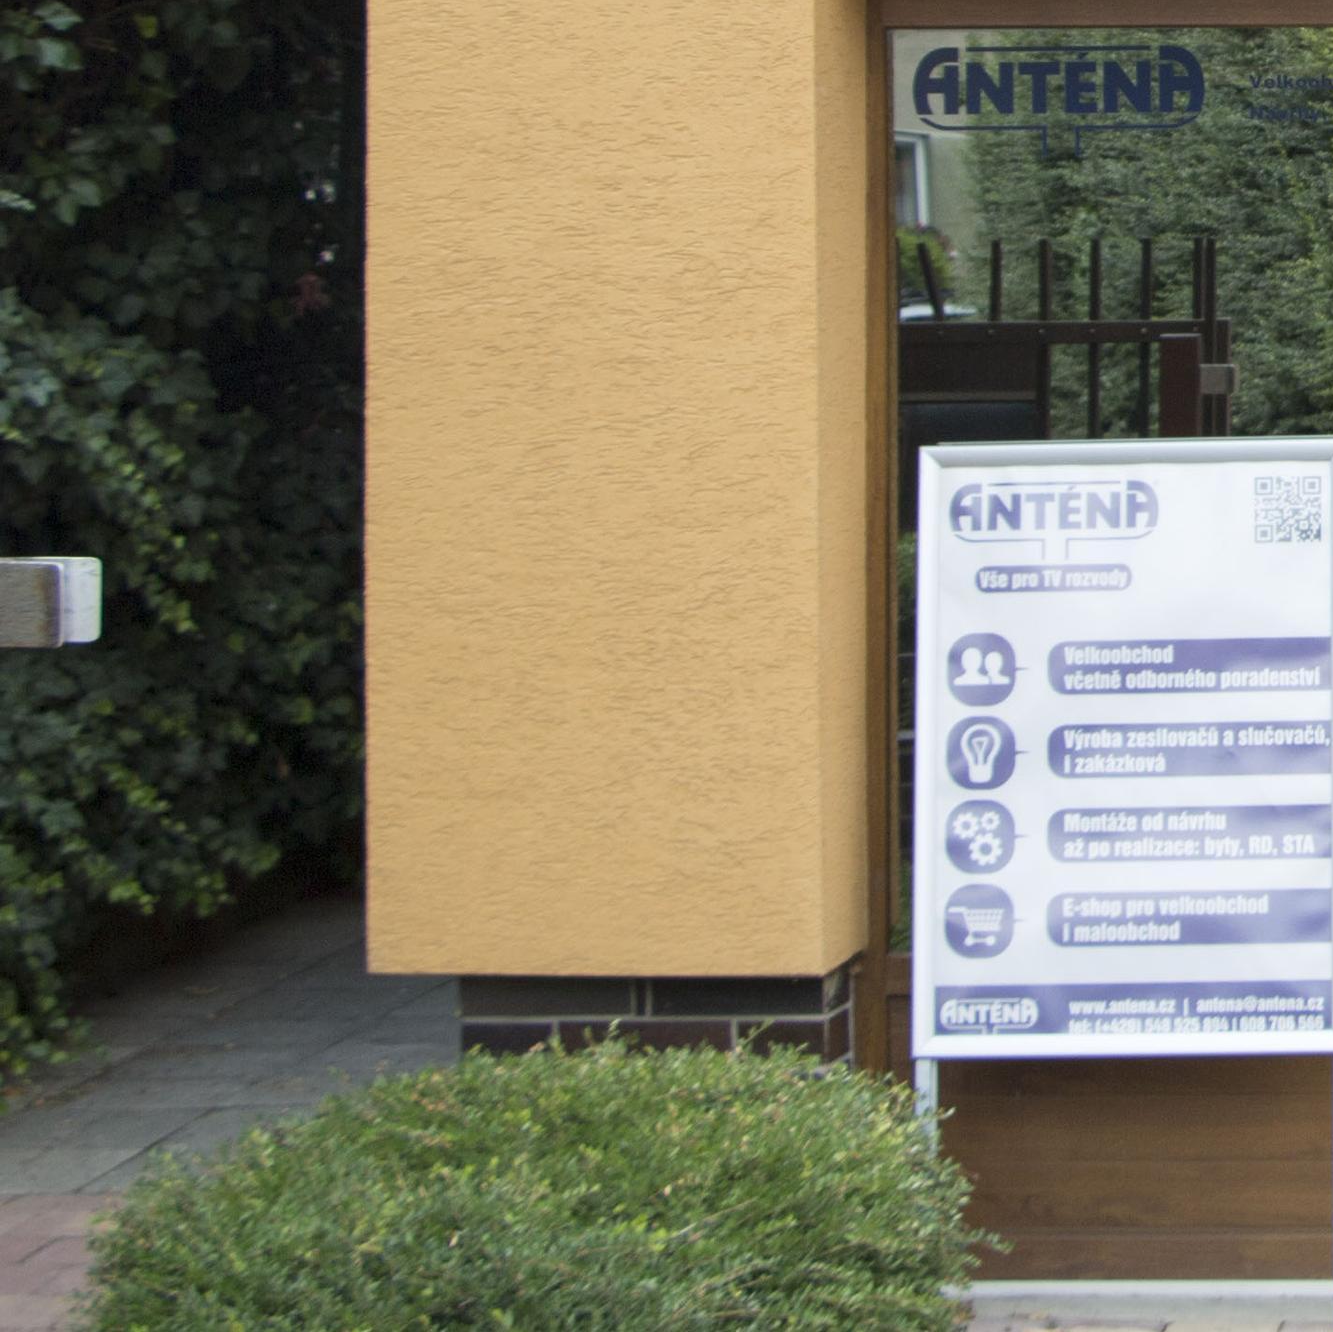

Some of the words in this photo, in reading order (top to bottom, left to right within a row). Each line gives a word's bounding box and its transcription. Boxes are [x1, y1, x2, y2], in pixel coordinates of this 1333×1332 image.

[913, 46, 1206, 116] ANTÉNA
[949, 480, 1159, 532] ANTÉNA
[978, 570, 1009, 589] Vše
[1011, 571, 1039, 590] pro
[1042, 570, 1064, 588] TV
[1065, 569, 1128, 589] rozvody
[1063, 644, 1175, 666] Velkoobchod
[1063, 669, 1122, 690] včetně
[1125, 667, 1216, 689] odborného
[1220, 666, 1321, 689] poradenství
[1063, 729, 1123, 751] Výroba
[1127, 727, 1219, 747] zesilovačů
[1222, 731, 1235, 746] a
[1074, 753, 1167, 773] zakázková
[1063, 813, 1138, 833] Montáže
[1141, 813, 1164, 832] od
[1167, 811, 1227, 831] návrhu
[1063, 839, 1085, 858] až
[1087, 841, 1111, 860] po
[1114, 837, 1200, 857] realizace:
[1204, 836, 1245, 858] byty,
[1248, 835, 1279, 856] RD,
[1282, 834, 1316, 854] STA
[1062, 897, 1122, 918] E-shop
[1125, 899, 1154, 918] pro
[1159, 894, 1270, 915] velkoobchod
[1074, 920, 1181, 942] maloobchod
[1068, 997, 1176, 1014] www.antena.cz
[1196, 995, 1325, 1013] antena@antena.cz
